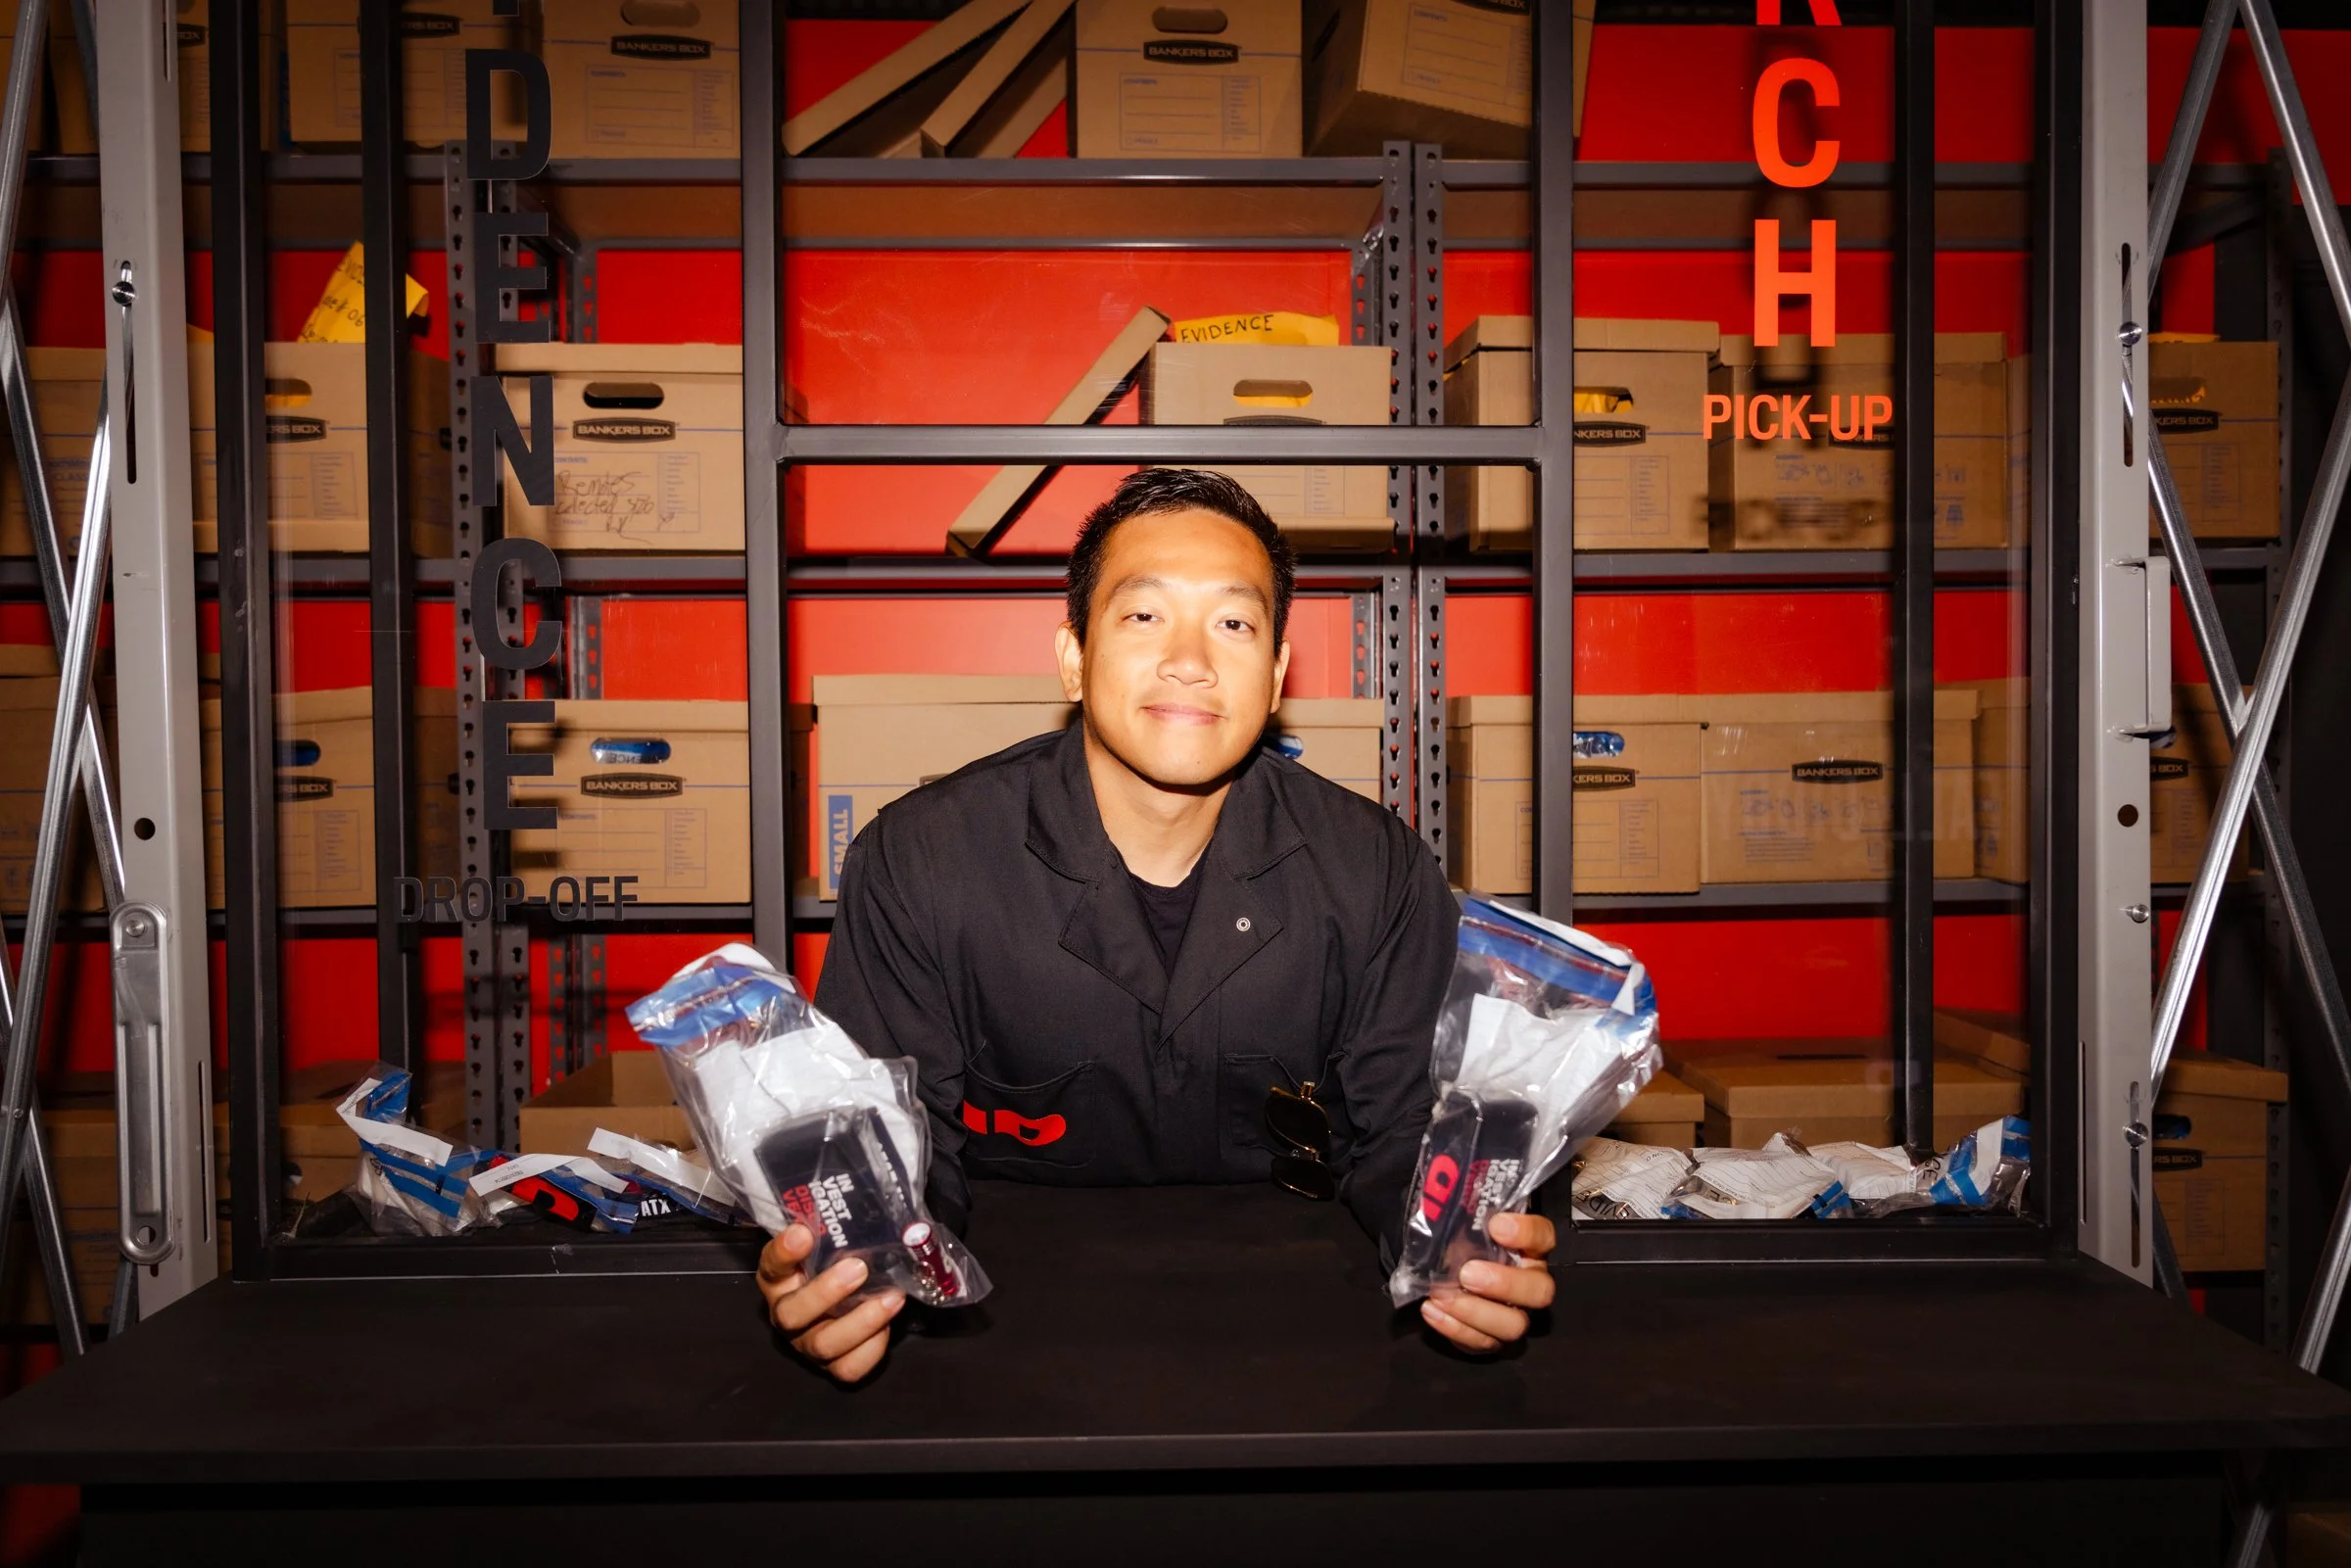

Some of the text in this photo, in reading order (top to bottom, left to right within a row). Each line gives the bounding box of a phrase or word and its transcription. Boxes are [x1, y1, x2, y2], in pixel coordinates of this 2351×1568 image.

[616, 41, 706, 54] BANKERS BOX
[1148, 46, 1234, 58] BANKERS BOX
[1752, 0, 1841, 347] CH
[1180, 314, 1274, 343] EVIDENCE
[465, 0, 562, 831] DENCE
[1703, 393, 1893, 441] PICK-UP
[2155, 415, 2214, 425] KERS BOX
[290, 425, 321, 434] BOX
[577, 425, 671, 435] BANKERS BOX
[1573, 429, 1642, 440] NKERS BOX
[1796, 767, 1880, 777] BANKERS BOX
[2158, 764, 2184, 773] BOX
[1573, 774, 1631, 784] KERS BOX
[299, 783, 329, 792] BOX
[587, 781, 679, 790] BANKERS BOX
[833, 808, 849, 876] SMALL
[394, 875, 639, 924] DROP-OFF
[2171, 1155, 2197, 1164] BOX
[835, 1172, 855, 1194] IN
[822, 1174, 853, 1221] VEST
[641, 1197, 671, 1217] ATX
[808, 1180, 849, 1249] IGATION
